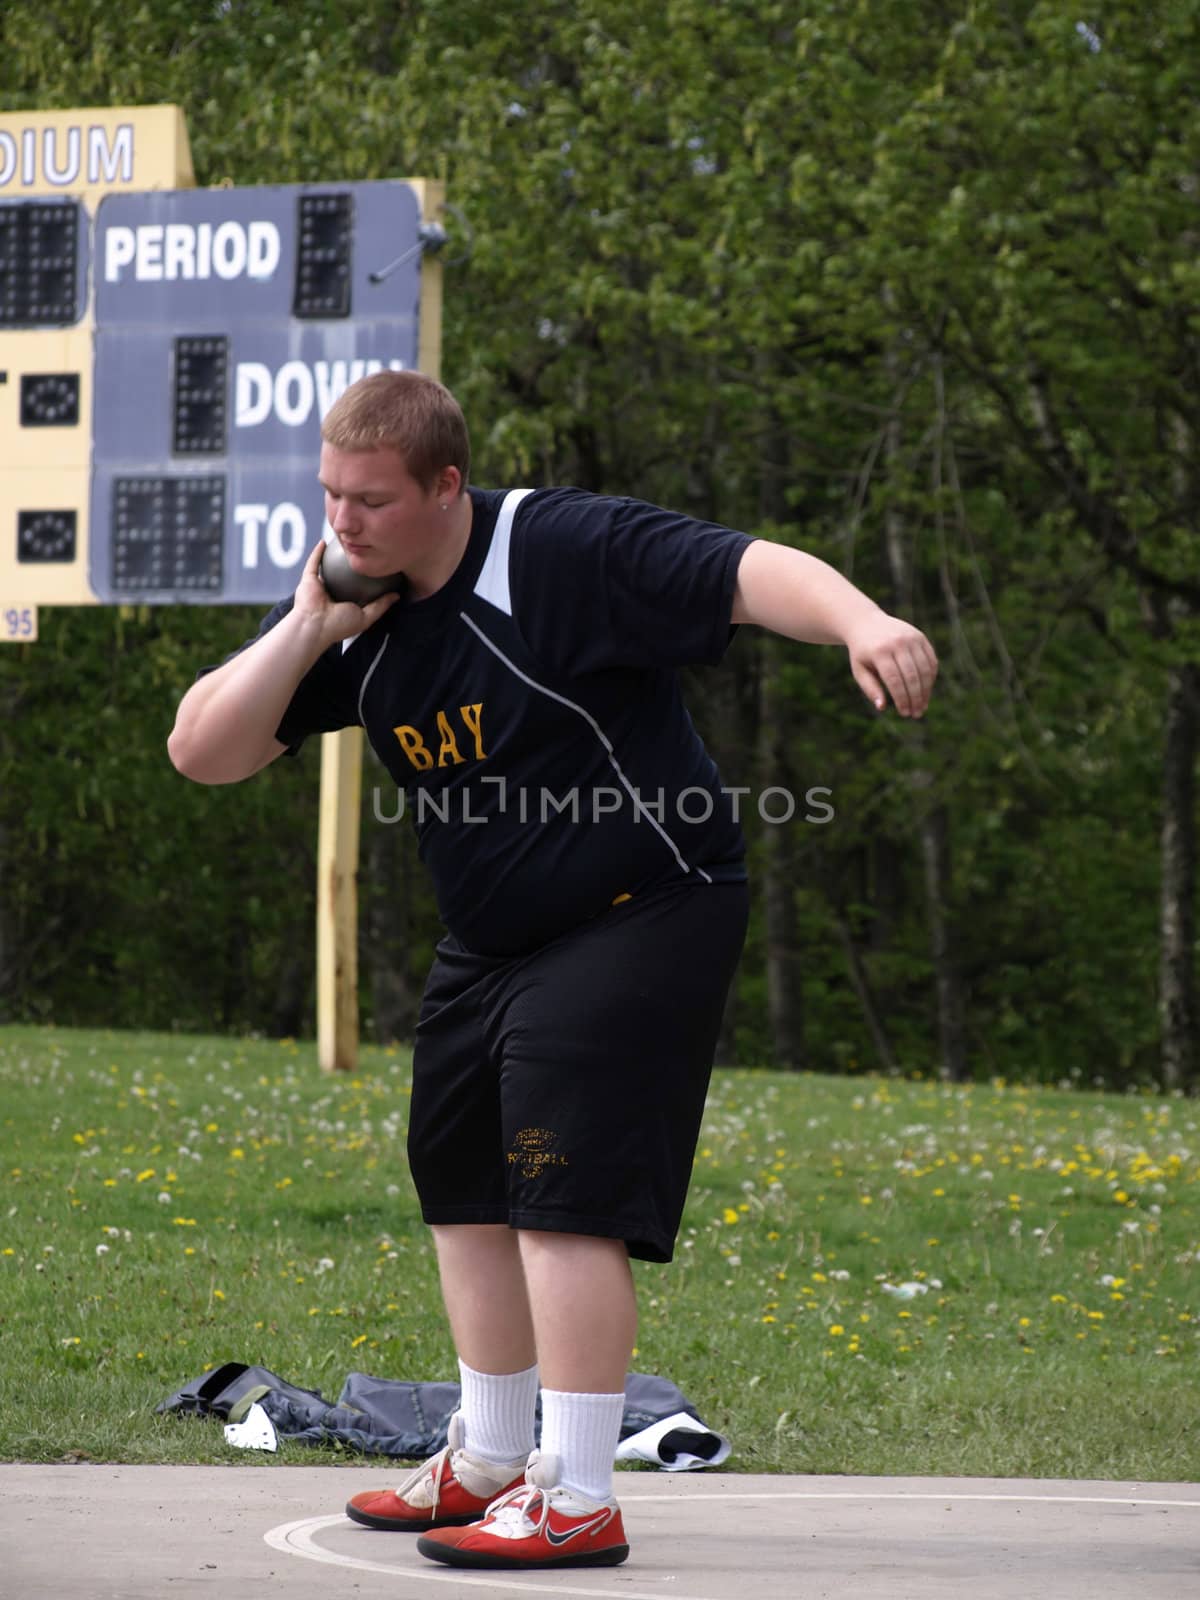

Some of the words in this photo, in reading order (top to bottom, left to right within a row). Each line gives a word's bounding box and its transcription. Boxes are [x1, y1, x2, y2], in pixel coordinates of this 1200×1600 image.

[105, 220, 281, 282] PERIOD
[234, 359, 404, 427] DOW
[233, 501, 307, 569] TO
[392, 703, 488, 772] BAY
